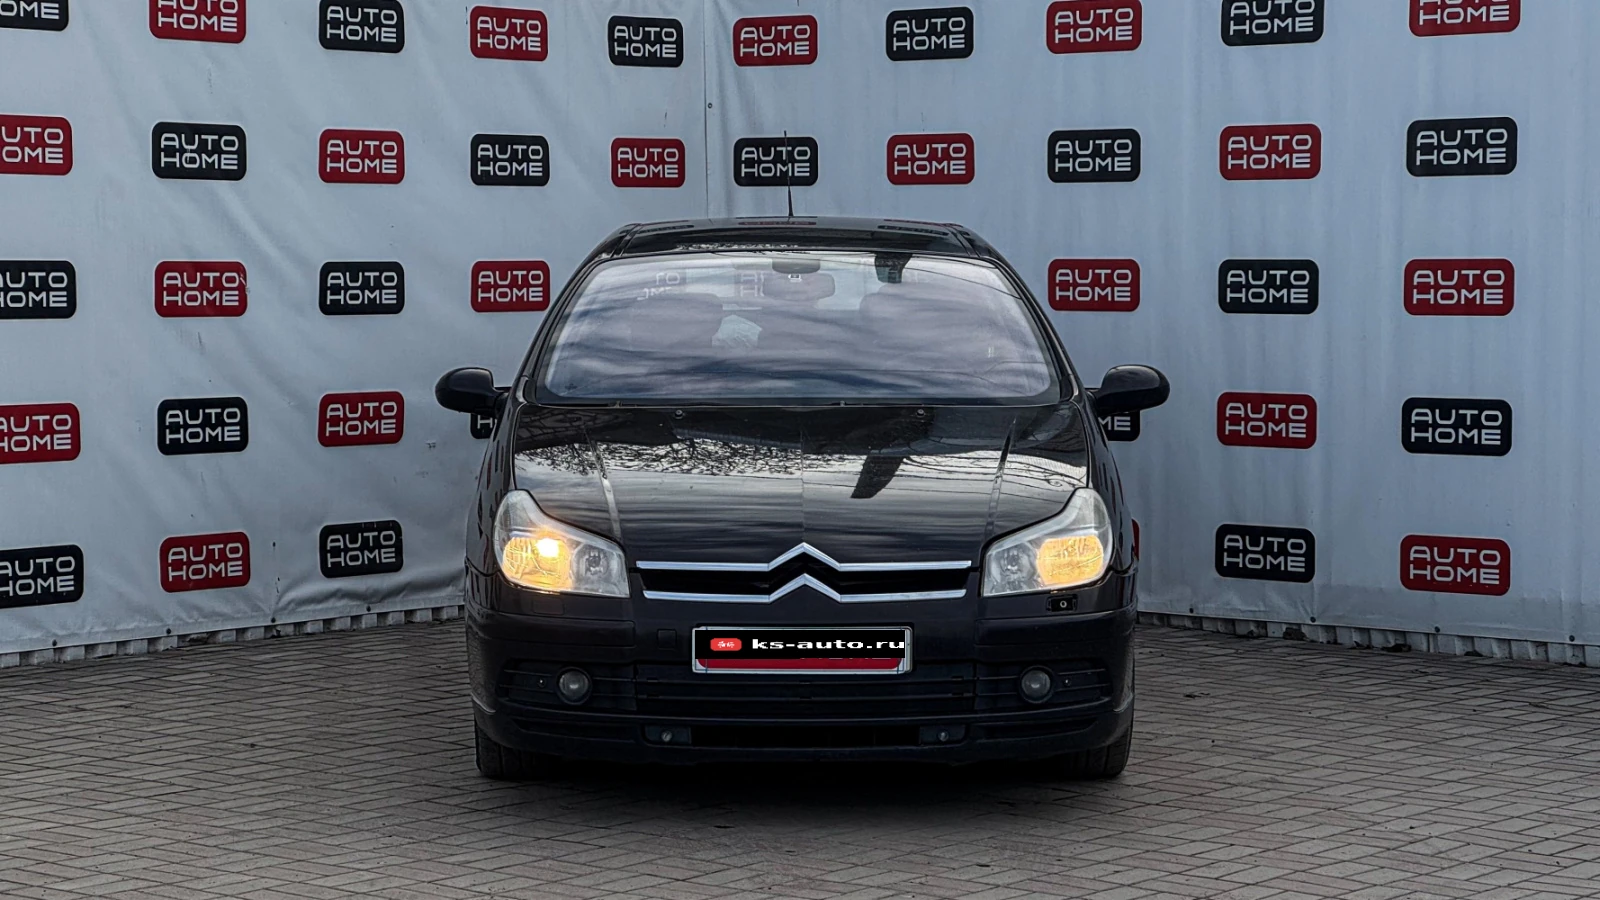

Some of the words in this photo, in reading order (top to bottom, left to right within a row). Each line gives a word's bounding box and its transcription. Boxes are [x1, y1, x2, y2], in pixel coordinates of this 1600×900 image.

[327, 6, 397, 24] AUTO
[1231, 0, 1315, 17] AUTO
[1420, 5, 1509, 25] HOME
[158, 12, 237, 32] HOME
[1055, 8, 1133, 26] AUTO
[327, 24, 396, 42] HOME
[478, 17, 541, 34] AUTO
[615, 26, 676, 41] AUTO
[741, 25, 810, 40] AUTO
[894, 17, 965, 34] AUTO
[1230, 16, 1313, 35] HOME
[478, 34, 541, 51] HOME
[894, 34, 964, 51] HOME
[1055, 26, 1132, 43] HOME
[615, 42, 676, 57] HOME
[740, 41, 809, 56] HOME
[2, 126, 63, 144] UTO
[161, 133, 238, 151] AUTO
[1228, 135, 1312, 151] AUTO
[1417, 129, 1507, 146] AUTO
[2, 146, 63, 163] OME
[327, 140, 397, 156] AUTO
[478, 144, 543, 159] AUTO
[618, 148, 678, 161] AUTO
[742, 147, 810, 160] AUTO
[894, 144, 966, 158] AUTO
[1056, 139, 1132, 155] AUTO
[161, 152, 237, 169] HOME
[1056, 157, 1131, 172] HOME
[1228, 153, 1310, 169] HOME
[1416, 148, 1506, 165] HOME
[327, 158, 396, 173] HOME
[478, 161, 542, 176] HOME
[618, 164, 678, 177] HOME
[741, 163, 809, 176] HOME
[895, 160, 965, 175] HOME
[0, 272, 67, 288] UTO
[164, 273, 239, 287] AUTO
[328, 272, 397, 286] AUTO
[479, 271, 543, 285] AUTO
[1056, 269, 1131, 283] AUTO
[1227, 270, 1309, 285] AUTO
[1414, 270, 1504, 285] AUTO
[0, 291, 67, 307] OME
[164, 291, 238, 306] HOME
[327, 290, 396, 304] HOME
[478, 288, 543, 302] HOME
[1056, 287, 1130, 301] HOME
[1227, 288, 1308, 303] HOME
[1413, 289, 1503, 304] HOME
[166, 408, 240, 425] AUTO
[327, 402, 397, 418] AUTO
[1226, 403, 1307, 419] AUTO
[1412, 409, 1502, 426] AUTO
[166, 426, 240, 444] HOME
[326, 419, 396, 436] HOME
[1226, 421, 1306, 438] HOME
[1411, 427, 1501, 445] HOME
[327, 531, 395, 550] AUTO
[1224, 535, 1306, 553] AUTO
[168, 543, 242, 563] AUTO
[327, 548, 395, 567] HOME
[1410, 546, 1500, 565] AUTO
[0, 556, 75, 576] AUTO
[1224, 552, 1305, 572] HOME
[168, 561, 242, 581] HOME
[1410, 564, 1499, 584] HOME
